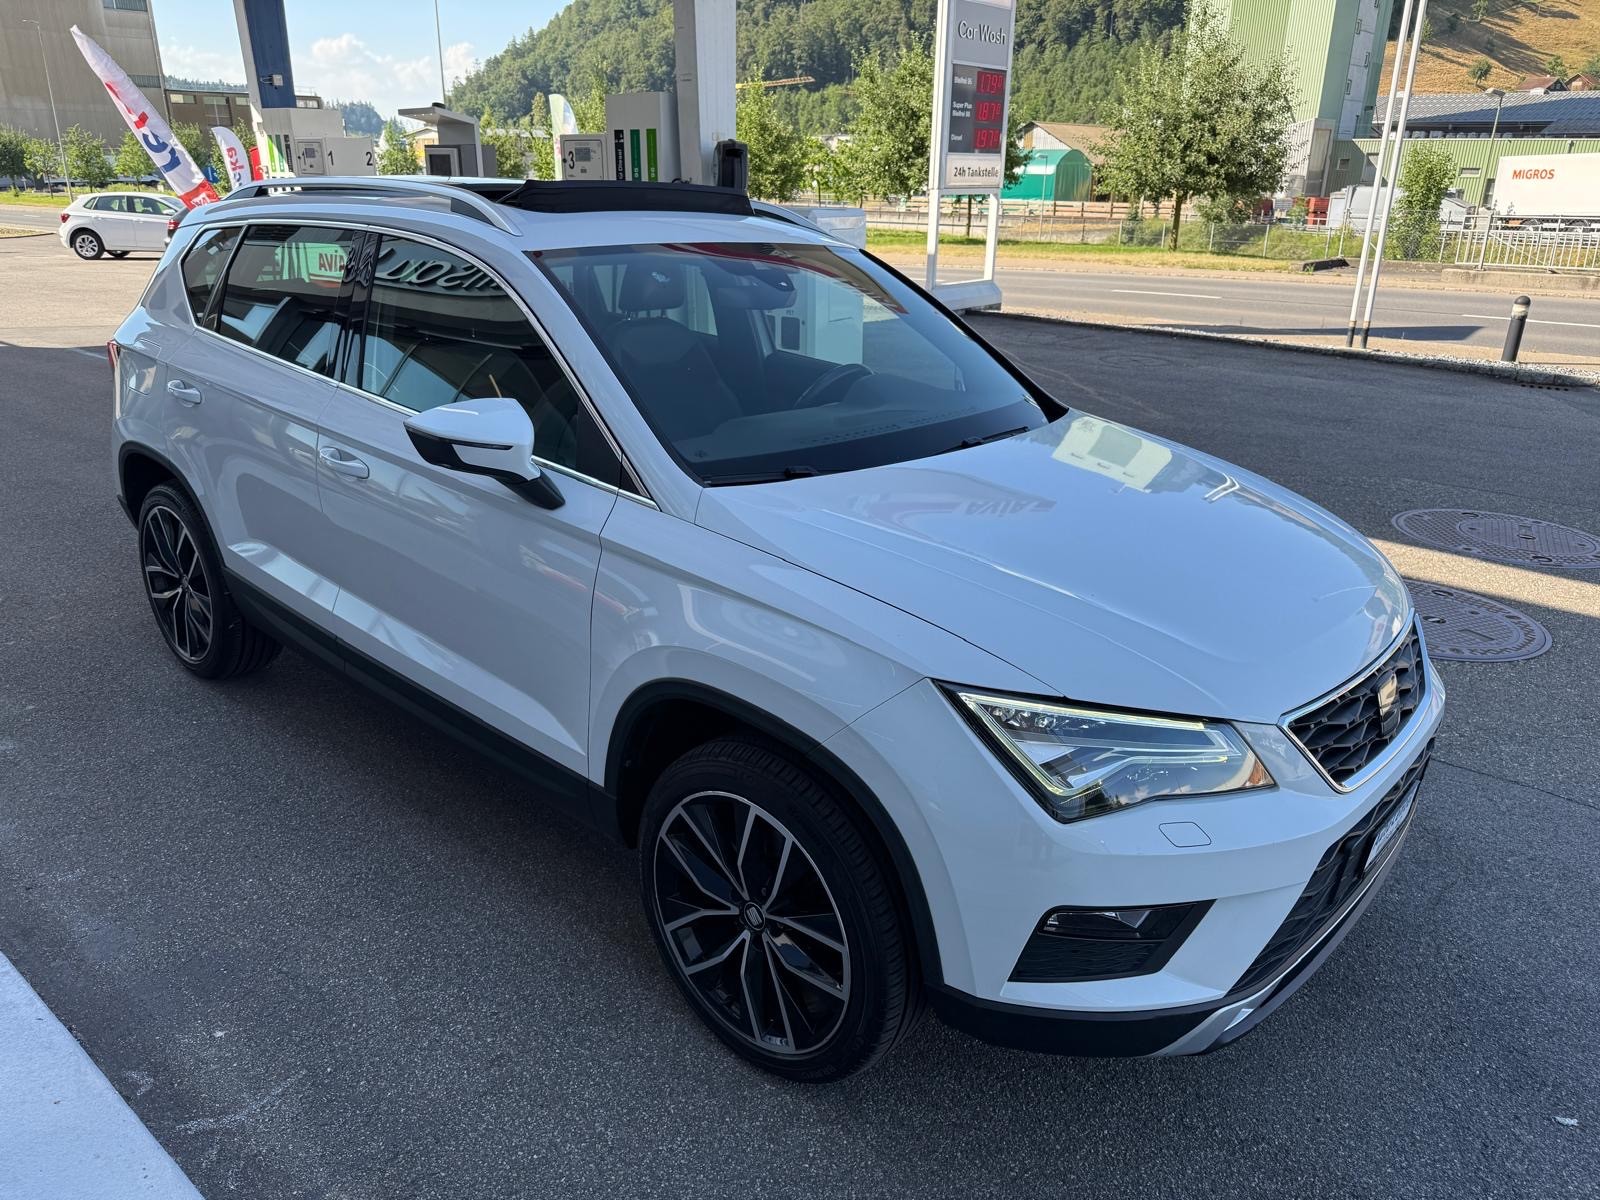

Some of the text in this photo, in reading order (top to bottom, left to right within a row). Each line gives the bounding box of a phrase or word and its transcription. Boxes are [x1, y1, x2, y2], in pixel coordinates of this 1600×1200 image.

[958, 20, 1007, 45] Car Wash
[328, 150, 334, 166] 1
[365, 151, 373, 166] 2
[568, 150, 575, 169] 3
[953, 166, 999, 178] 24h Tankstelle
[1511, 168, 1555, 180] MIGROS
